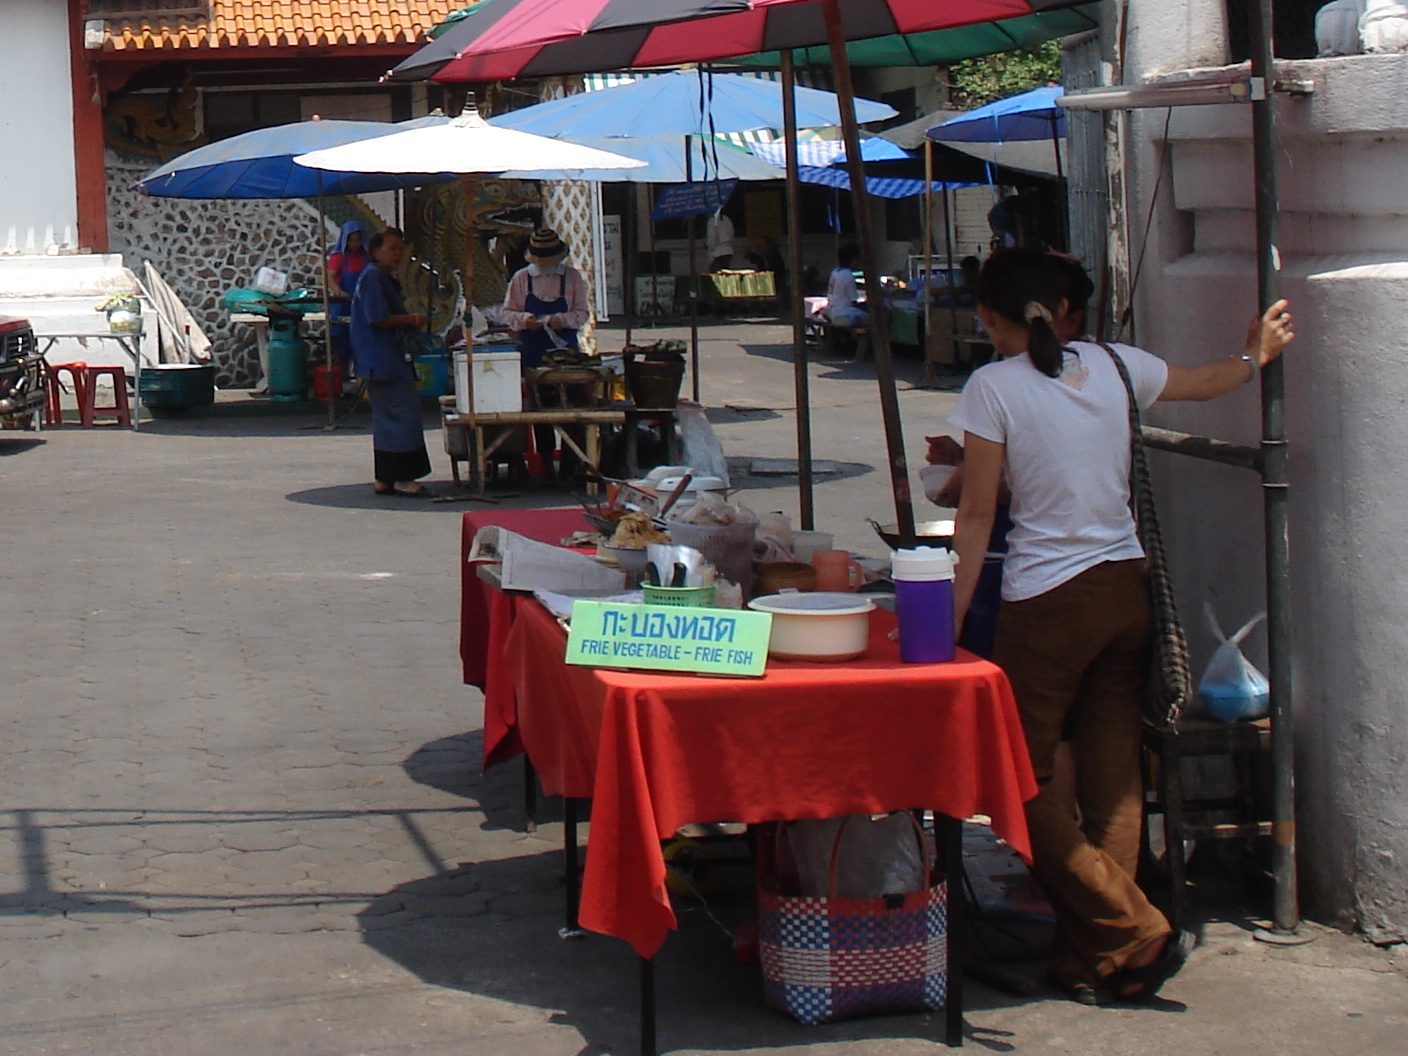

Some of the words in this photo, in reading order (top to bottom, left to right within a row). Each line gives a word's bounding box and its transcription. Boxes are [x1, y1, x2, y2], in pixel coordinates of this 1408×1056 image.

[601, 610, 736, 643] กะบองทอด
[580, 638, 609, 655] FRIE
[613, 641, 681, 660] VEGETABLE
[694, 647, 723, 663] FRIE
[726, 649, 753, 666] FISH
